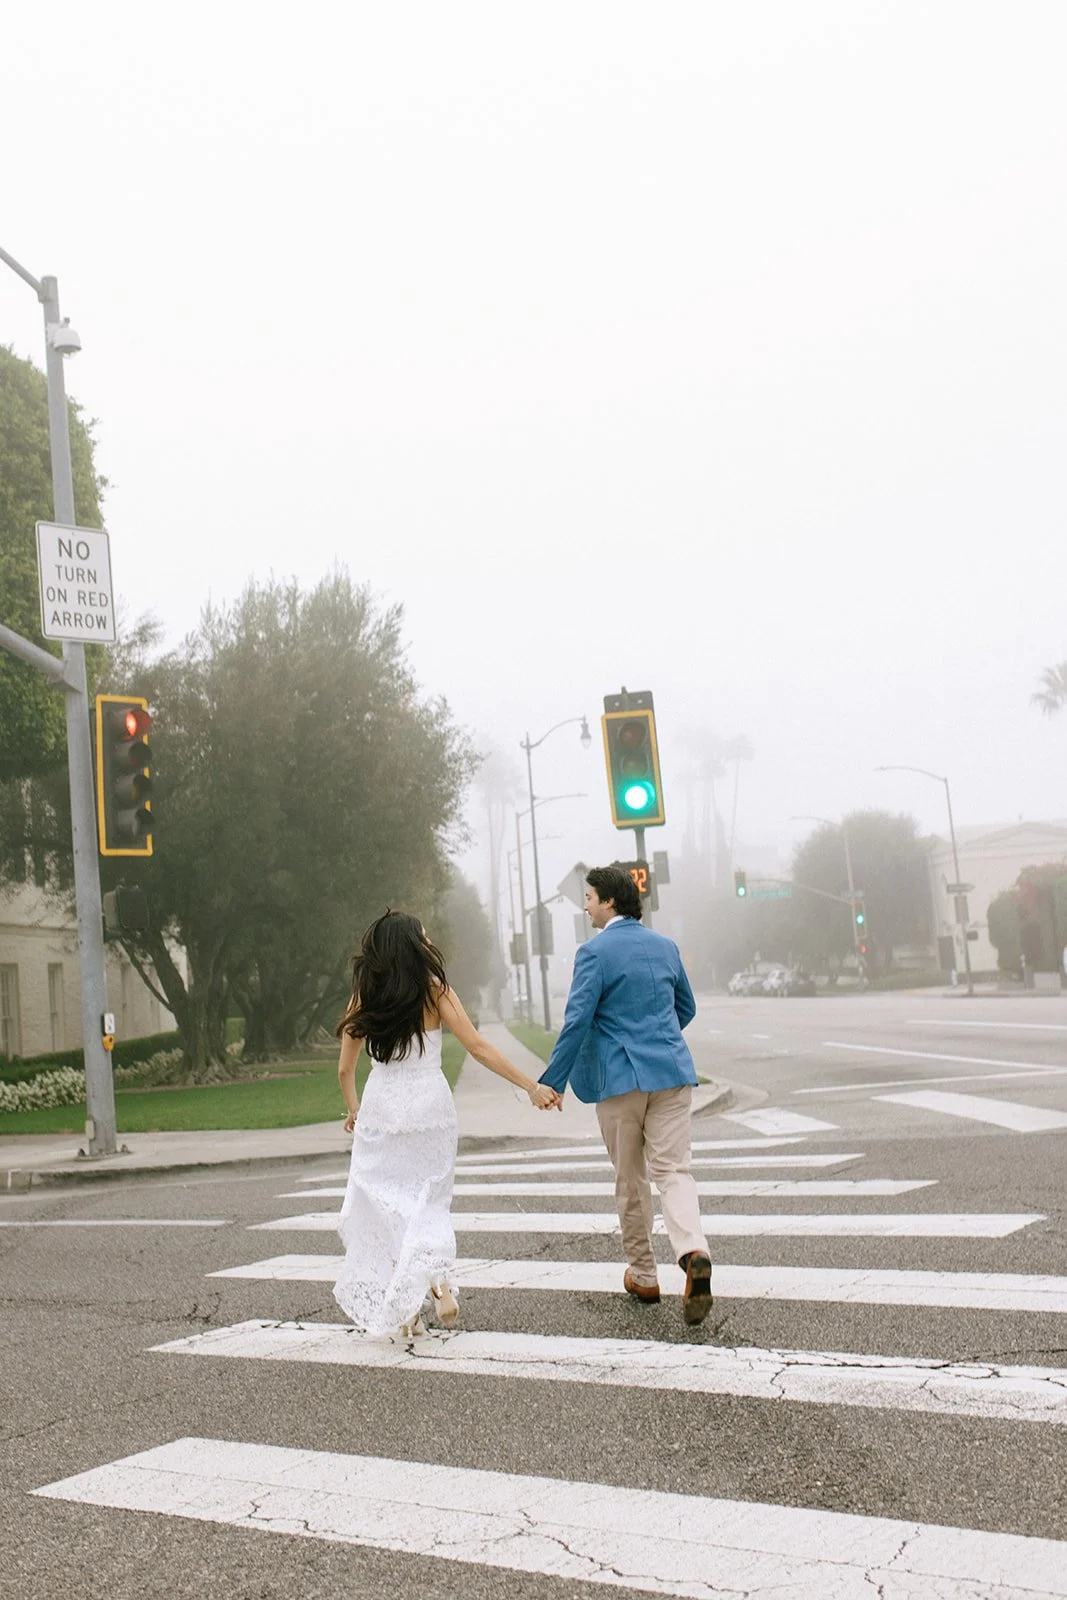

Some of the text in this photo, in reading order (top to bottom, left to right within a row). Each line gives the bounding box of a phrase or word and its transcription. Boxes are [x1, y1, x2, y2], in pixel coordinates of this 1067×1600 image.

[57, 537, 90, 560] NO
[55, 564, 97, 584] TURN
[46, 586, 109, 608] ON RED
[51, 610, 107, 630] ARROW
